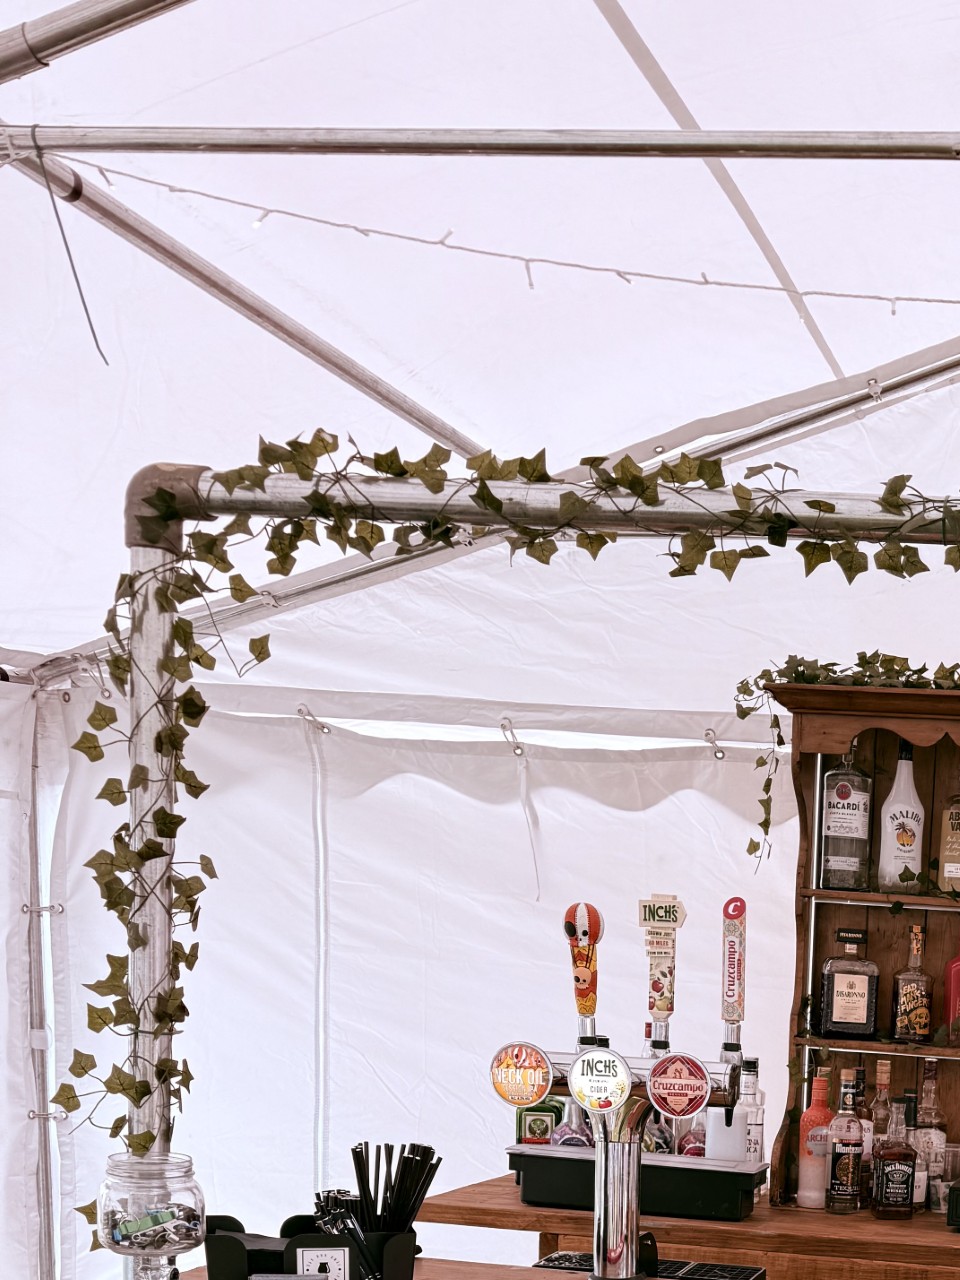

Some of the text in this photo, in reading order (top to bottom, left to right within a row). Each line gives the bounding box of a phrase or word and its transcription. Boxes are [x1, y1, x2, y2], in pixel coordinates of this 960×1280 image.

[827, 800, 861, 812] BACARDÍ
[642, 904, 678, 923] INCH'S
[725, 940, 738, 998] Cruzcampo
[835, 990, 866, 999] DISARONNO
[580, 1058, 618, 1077] INCH'S
[495, 1068, 546, 1085] NECK OIL
[653, 1080, 704, 1093] Cruzcampo
[884, 1163, 895, 1173] JACK
